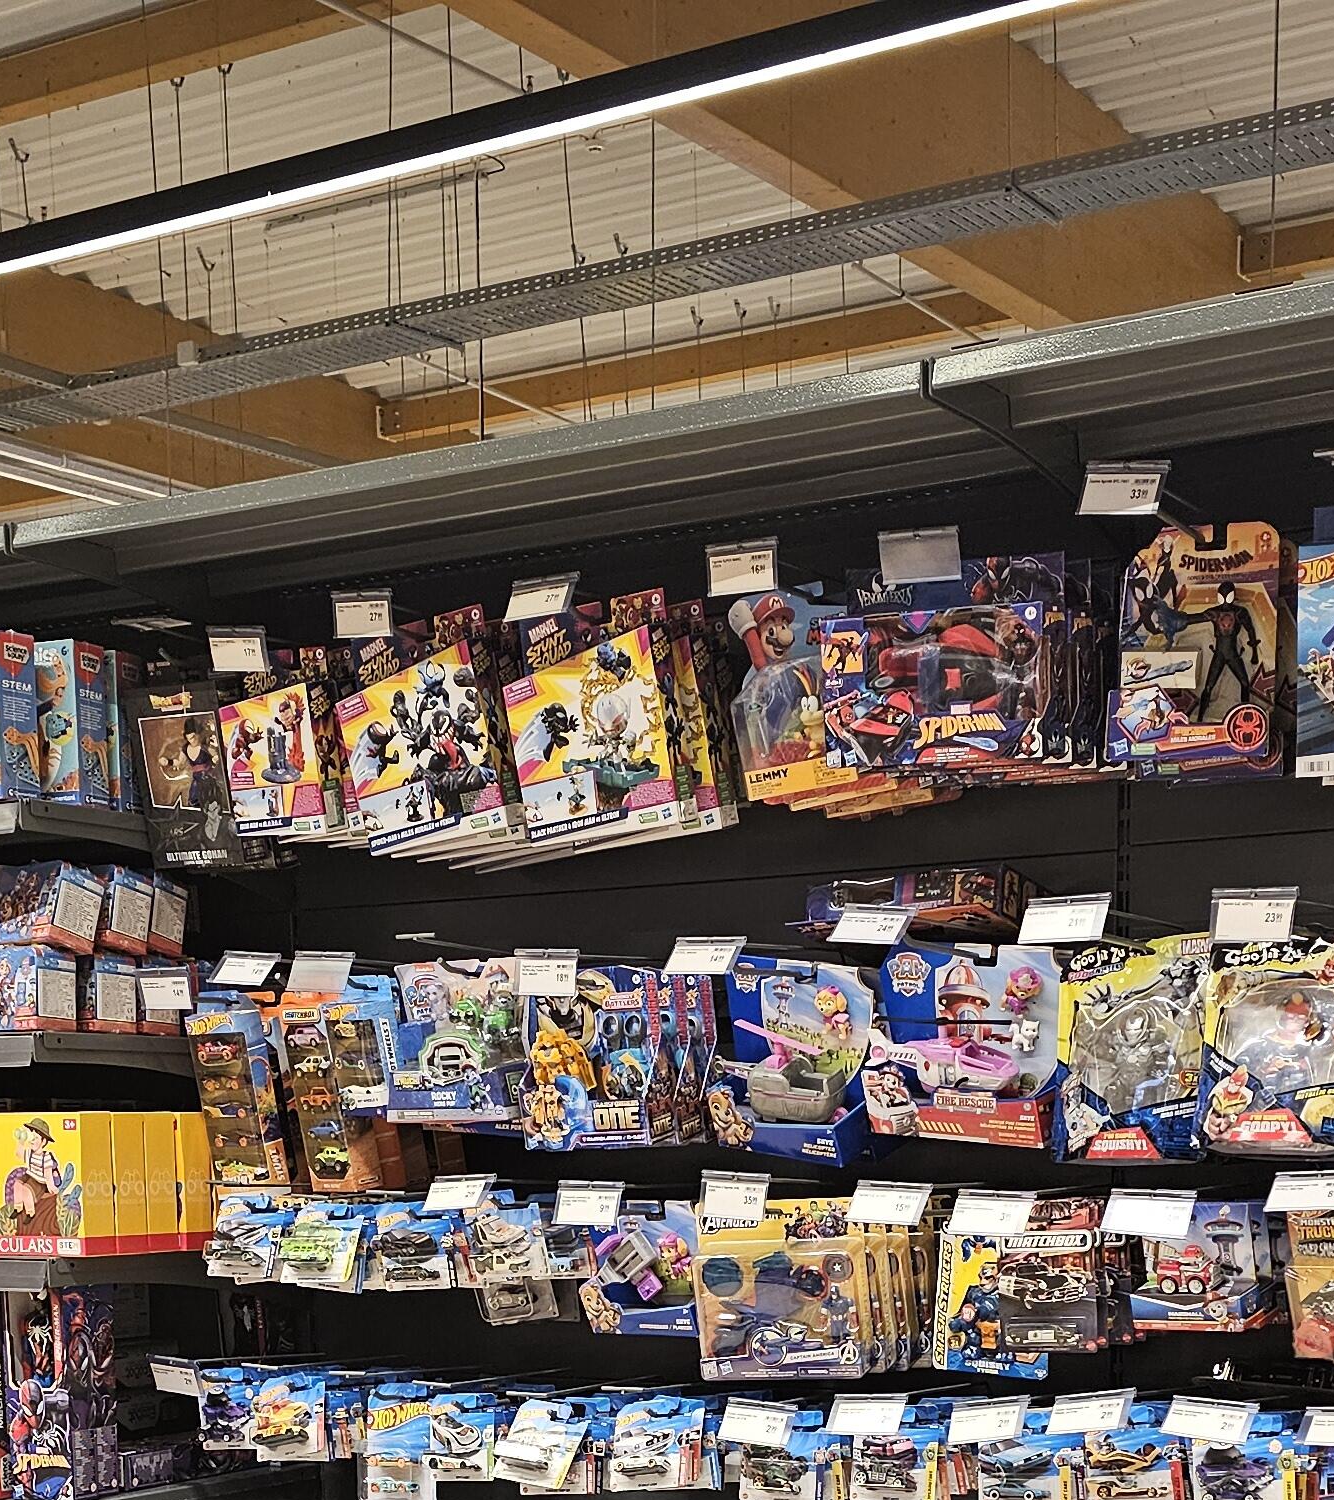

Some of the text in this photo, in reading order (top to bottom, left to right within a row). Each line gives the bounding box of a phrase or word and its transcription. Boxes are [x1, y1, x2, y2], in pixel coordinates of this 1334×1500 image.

[1179, 548, 1255, 572] SPIDER-MAN
[529, 618, 558, 642] MARVEL
[526, 635, 562, 663] STUNT
[532, 642, 572, 673] SQUAD
[914, 711, 1007, 749] SPIDER-MAN
[749, 768, 789, 784] LEMMY
[888, 962, 929, 983] PAW
[937, 1095, 994, 1109] FIRE RESCUE
[592, 1105, 642, 1130] ONE
[1005, 1233, 1085, 1249] MATCHBOX
